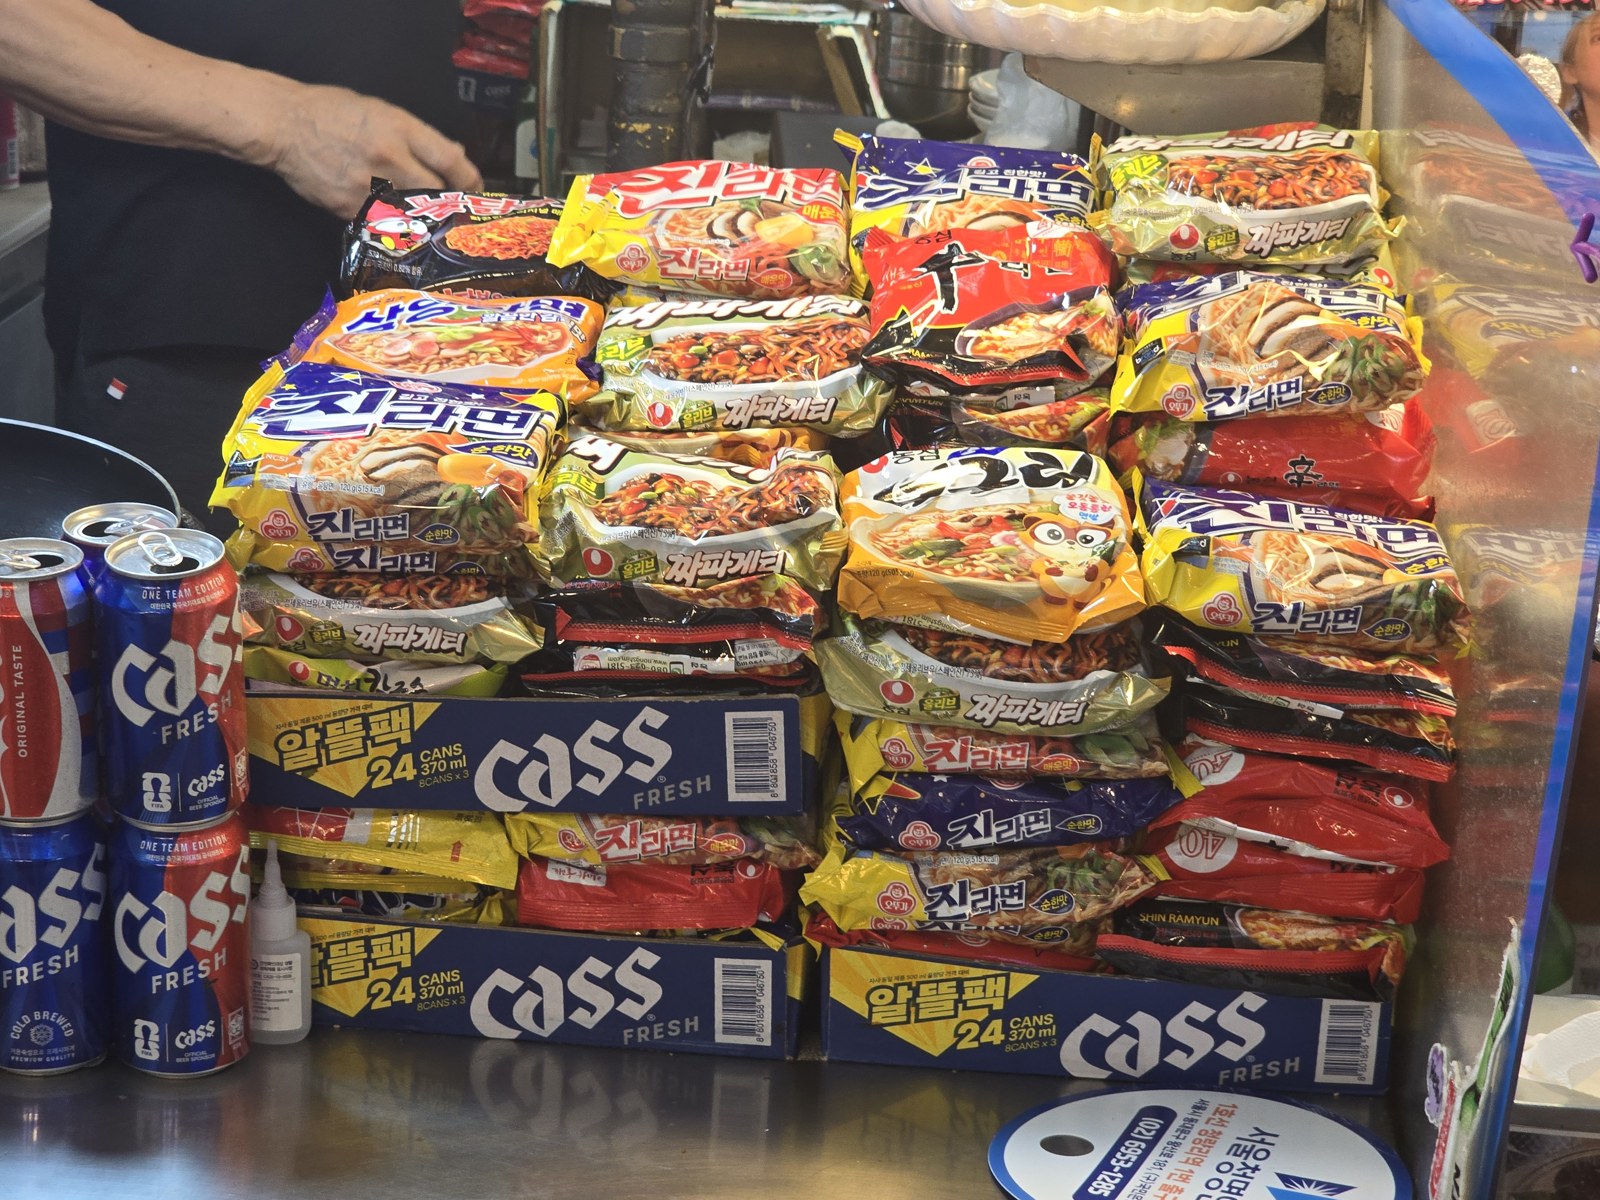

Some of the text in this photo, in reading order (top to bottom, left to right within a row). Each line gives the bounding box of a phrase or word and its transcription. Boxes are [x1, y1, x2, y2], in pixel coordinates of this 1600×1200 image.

[1207, 232, 1238, 251] 올리브
[1244, 217, 1353, 258] 짜파게티
[657, 248, 751, 281] 진라면
[1202, 376, 1303, 421] 진라면
[1316, 386, 1346, 404] 순한맛
[256, 387, 543, 442] 진라면
[682, 407, 714, 429] 올리브
[722, 395, 838, 429] 짜파게티
[469, 443, 533, 460] 순한맛
[306, 508, 410, 542] 진라면
[424, 528, 454, 542] 순한맛
[622, 557, 658, 579] 올리브
[663, 550, 786, 587] 짜파게티
[142, 588, 161, 600] ONE
[166, 585, 192, 600] TEAM
[194, 573, 225, 596] EDITION
[1250, 602, 1363, 635] 진라면
[1372, 624, 1406, 637] 순한맛
[353, 622, 469, 656] 짜파게티
[12, 644, 28, 759] ORIGINAL TASTE
[922, 696, 957, 711] 올리브
[963, 693, 1087, 728] 짜파게티
[161, 689, 232, 745] FRESH
[275, 706, 413, 773] 알뜰팩
[419, 743, 463, 763] CANS
[923, 737, 1031, 772] 진라면
[369, 752, 418, 790] 24
[418, 773, 453, 788] 8CANS
[462, 769, 470, 779] 3
[420, 757, 467, 776] 370 ml
[1043, 759, 1073, 772] 매운맛
[633, 774, 712, 810] FRESH
[1066, 816, 1096, 831] 순한맛
[140, 834, 228, 853] ONE TEAM EDITION
[594, 819, 697, 862] 진라면
[923, 878, 1026, 922] 진라면
[1040, 893, 1069, 909] 순한맛
[1139, 913, 1220, 927] SHIN RAMYUN
[2, 944, 80, 989] FRESH
[151, 947, 228, 994] FRESH
[312, 931, 413, 986] 뜰팩
[370, 976, 417, 1010] 24
[418, 969, 461, 988] CANS
[419, 981, 464, 1000] 370 ml
[416, 998, 451, 1012] 8CANS
[458, 996, 467, 1005] 3
[867, 975, 1007, 1025] 알뜰팩
[10, 1010, 75, 1041] COLD BREWED
[623, 1015, 701, 1046] FRESH
[956, 1019, 1006, 1050] 24
[1008, 1024, 1057, 1042] 370 ml
[1009, 1013, 1054, 1030] CANS
[1004, 1041, 1040, 1053] 8CANS
[1049, 1038, 1057, 1047] 3
[1218, 1056, 1300, 1086] FRESH
[1185, 1098, 1211, 1118] 서울시
[1203, 1102, 1239, 1127] 1호선
[1170, 1117, 1198, 1141] 동대문구
[1086, 1116, 1165, 1198] (02) 6953-1285
[1157, 1141, 1182, 1159] 왕산로
[1177, 1128, 1225, 1168] 청량리역
[1195, 1126, 1281, 1200] 서울청명
[1166, 1168, 1196, 1184] 1번
